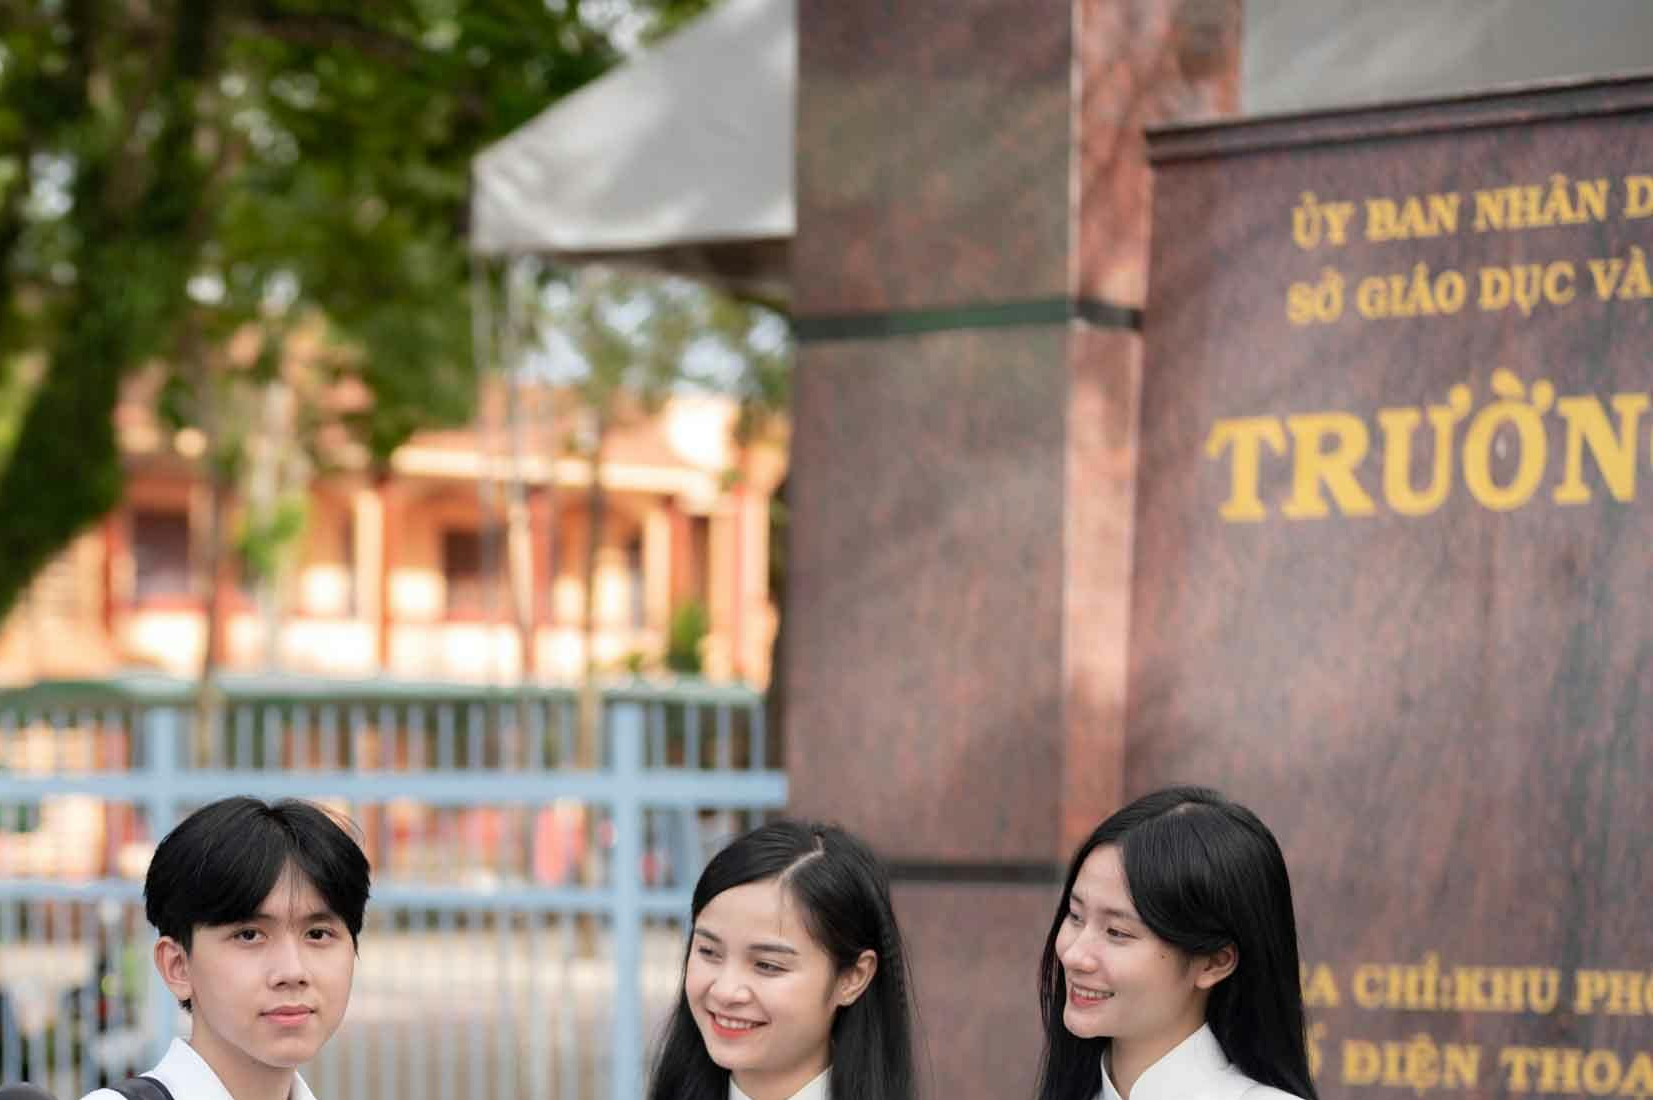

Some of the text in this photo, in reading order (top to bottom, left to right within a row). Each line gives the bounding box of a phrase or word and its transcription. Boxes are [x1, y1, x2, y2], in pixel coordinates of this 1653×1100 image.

[1364, 191, 1461, 241] BAN
[1473, 173, 1610, 233] NHÂN
[1356, 262, 1467, 319] GIÁO
[1479, 260, 1576, 318] DỤC
[1587, 245, 1653, 300] VÀ
[1203, 367, 1653, 523] TRƯỜN
